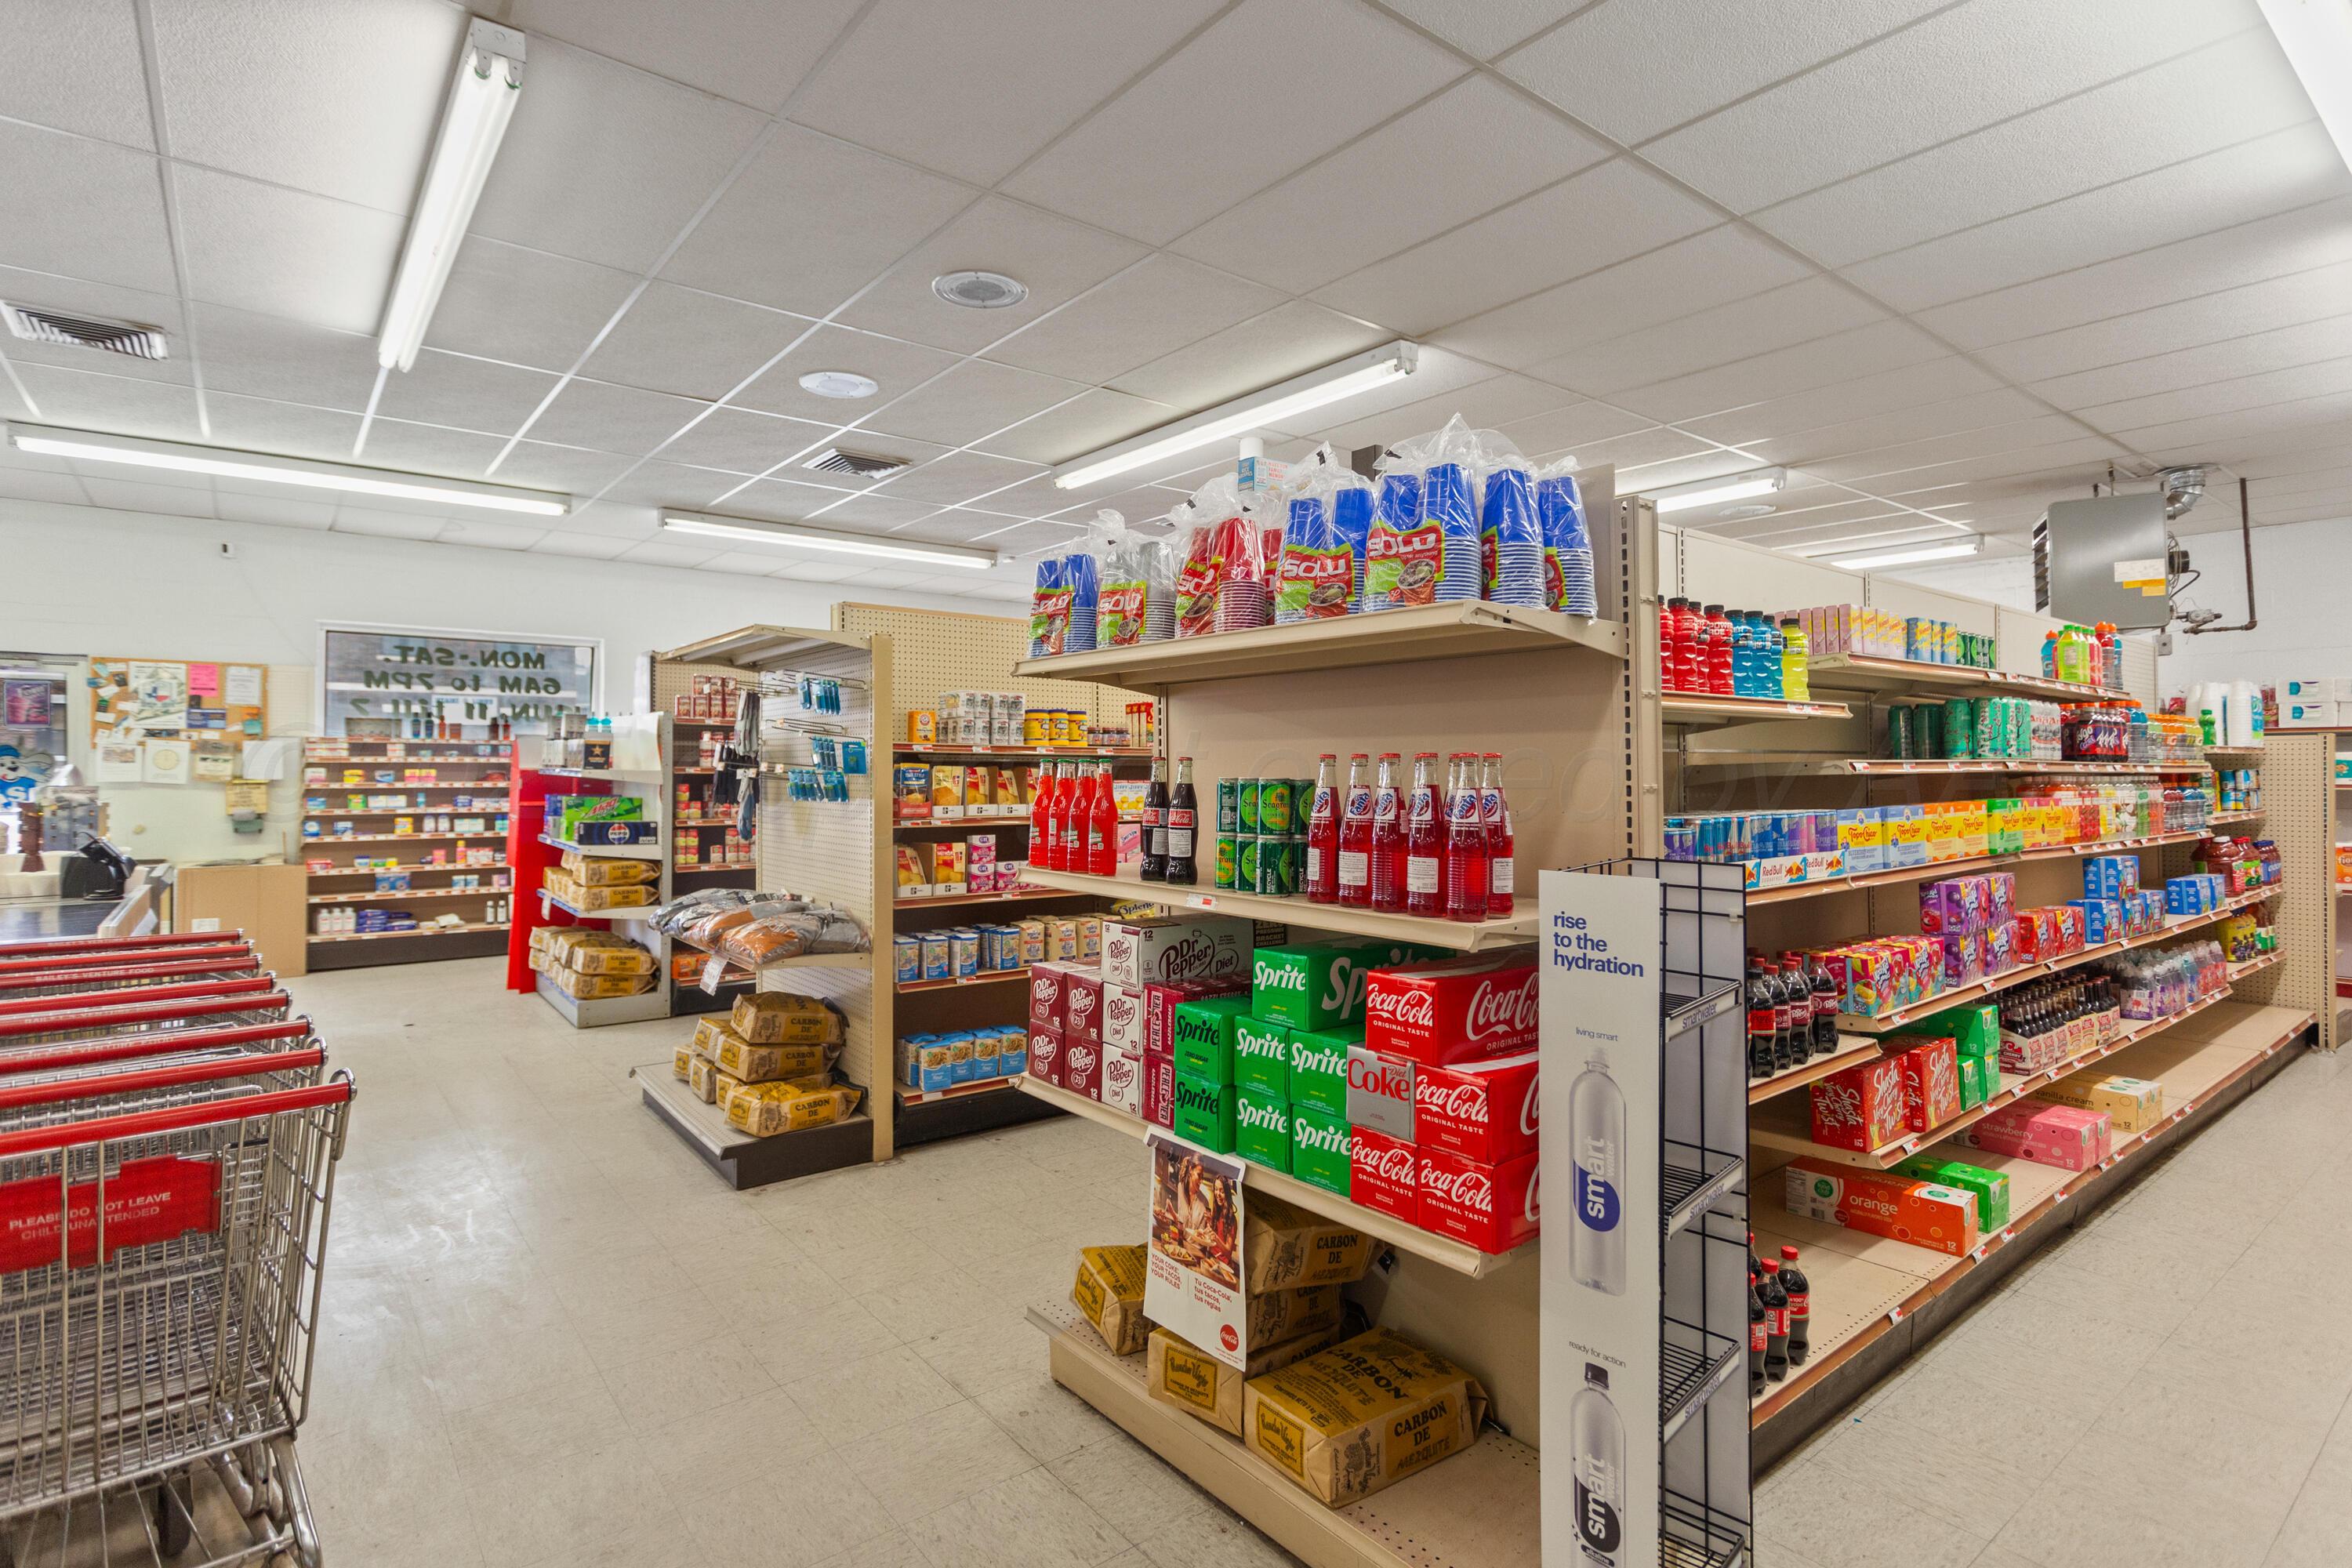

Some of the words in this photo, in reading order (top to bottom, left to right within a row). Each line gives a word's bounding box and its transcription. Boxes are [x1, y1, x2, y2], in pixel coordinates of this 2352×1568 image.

[1369, 533, 1436, 557] SOLO
[1414, 550, 1439, 559] anything
[1283, 558, 1346, 578] SOLO
[1350, 791, 1370, 816] Fanta
[1453, 793, 1477, 819] Fanta
[1762, 865, 1772, 876] Red
[1772, 863, 1783, 874] Bull
[1554, 911, 1587, 930] rise
[1143, 930, 1153, 938] 12
[1554, 931, 1572, 948] to
[1576, 933, 1607, 953] the
[1109, 941, 1130, 960] Pepper
[1179, 938, 1198, 958] Dr
[1165, 944, 1211, 980] Pepper
[1216, 955, 1234, 973] Diet
[1554, 949, 1644, 978] hydration
[1254, 960, 1306, 991] Sprite
[1035, 980, 1055, 1000] Pepper
[1071, 989, 1092, 1010] Pepper
[1109, 1000, 1132, 1020] Pepper
[1467, 971, 1539, 1041] Coca-Co
[1682, 1002, 1718, 1029] smartwater
[1090, 1028, 1097, 1036] 12
[1112, 1027, 1122, 1036] Diet
[1150, 1022, 1160, 1048] PEACE
[1176, 1015, 1218, 1046] Sprite
[1373, 1020, 1406, 1033] ORIGINAL
[1407, 1028, 1430, 1038] TASTE
[1576, 1026, 1595, 1039] living
[1595, 1032, 1618, 1042] smart
[1033, 1037, 1054, 1055] Pepper
[1236, 1028, 1286, 1061] Sprite
[1486, 1037, 1522, 1051] ORIGINAL
[1069, 1048, 1092, 1069] Pepper
[1291, 1042, 1347, 1076] Sprite
[1929, 1047, 1951, 1087] Shasta
[1108, 1062, 1131, 1083] Pepper
[1160, 1067, 1171, 1094] PEACE
[1348, 1058, 1410, 1102] Coke
[1388, 1065, 1406, 1078] Diet
[1112, 1089, 1120, 1098] Diet
[1874, 1062, 1899, 1104] Shasta
[795, 1098, 830, 1112] CARBON
[1129, 1102, 1137, 1111] 12
[1176, 1082, 1218, 1115] Sprite
[1416, 1074, 1489, 1124] Coca-Cola
[1836, 1085, 1863, 1127] Shasta
[2065, 1094, 2094, 1106] cream
[1237, 1098, 1287, 1134] Sprite
[1813, 1096, 1840, 1129] Twist
[1421, 1113, 1457, 1129] ORIGINAL
[1459, 1123, 1484, 1134] TASTE
[1981, 1122, 2033, 1140] strawberry
[1294, 1118, 1351, 1156] Sprite
[1352, 1137, 1415, 1187] Coca-Cola
[2066, 1158, 2074, 1167] 12
[1358, 1173, 1389, 1189] ORIGINAL
[1391, 1185, 1413, 1197] TASTE
[1421, 1159, 1492, 1213] Coca-Cola
[1587, 1136, 1606, 1219] smart
[70, 1206, 90, 1218] DO
[96, 1200, 124, 1212] OT
[128, 1192, 172, 1207] LEAVE
[1427, 1197, 1461, 1214] ORIGINAL
[1464, 1210, 1488, 1223] TASTE
[1689, 1181, 1725, 1220] smartwater
[1849, 1193, 1898, 1216] orange
[69, 1206, 160, 1231] UNATENDED
[1317, 1235, 1358, 1250] CARBON
[1947, 1241, 1956, 1250] 12
[1151, 1261, 1164, 1272] YOUR
[1152, 1254, 1164, 1265] YOUR
[1328, 1251, 1341, 1264] DE
[1150, 1269, 1164, 1279] YOUR
[1165, 1275, 1181, 1290] RULES
[1195, 1278, 1202, 1287] Tu
[1194, 1286, 1203, 1296] tus
[1204, 1290, 1221, 1305] tacos,
[1194, 1294, 1203, 1305] tus
[1204, 1298, 1221, 1312] reglas
[1308, 1296, 1319, 1310] DE
[1220, 1330, 1239, 1345] Coca-Cola
[1568, 1339, 1588, 1356] ready
[1590, 1345, 1601, 1357] for
[1602, 1348, 1627, 1369] action
[1327, 1348, 1410, 1399] CARBON
[1341, 1363, 1365, 1380] DE
[1684, 1372, 1722, 1420] smartwater
[1394, 1401, 1447, 1437] CARBON
[1414, 1426, 1431, 1446] DE
[1587, 1453, 1606, 1540] smart
[1585, 1546, 1610, 1564] alkaline
